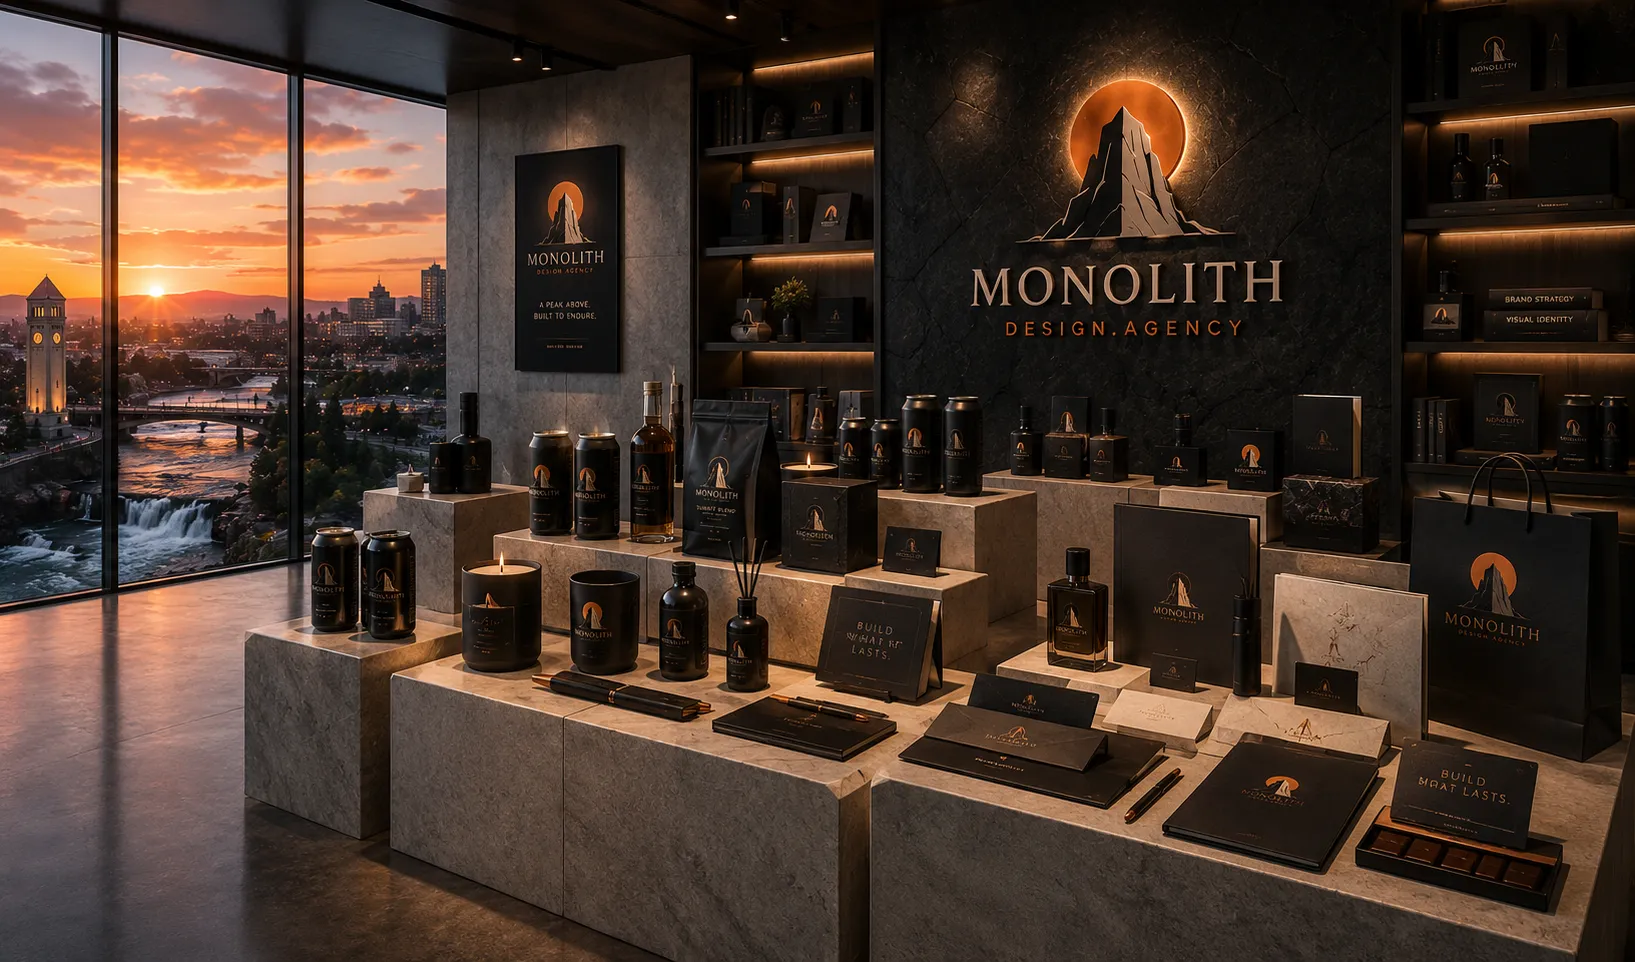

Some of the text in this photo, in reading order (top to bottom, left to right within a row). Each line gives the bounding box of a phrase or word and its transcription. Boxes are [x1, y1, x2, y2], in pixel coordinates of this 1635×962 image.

[527, 250, 604, 266] MONOLITH
[970, 259, 1283, 307] MONOLITH
[539, 300, 591, 309] A PEAK ABOVE.
[1505, 295, 1575, 304] BRAND STRATEGY
[533, 312, 553, 320] BUILT
[555, 312, 565, 320] TO
[1506, 316, 1534, 324] VISUAL
[1005, 319, 1244, 337] DESIGN.AGENCY
[695, 489, 739, 500] MONOLITH
[1153, 606, 1205, 621] MONOLITH
[857, 621, 893, 636] BUILD
[1444, 611, 1540, 642] MONOLITH
[851, 644, 891, 660] LASTS.
[1440, 769, 1487, 787] BUILD
[1462, 786, 1511, 805] LASTS.
